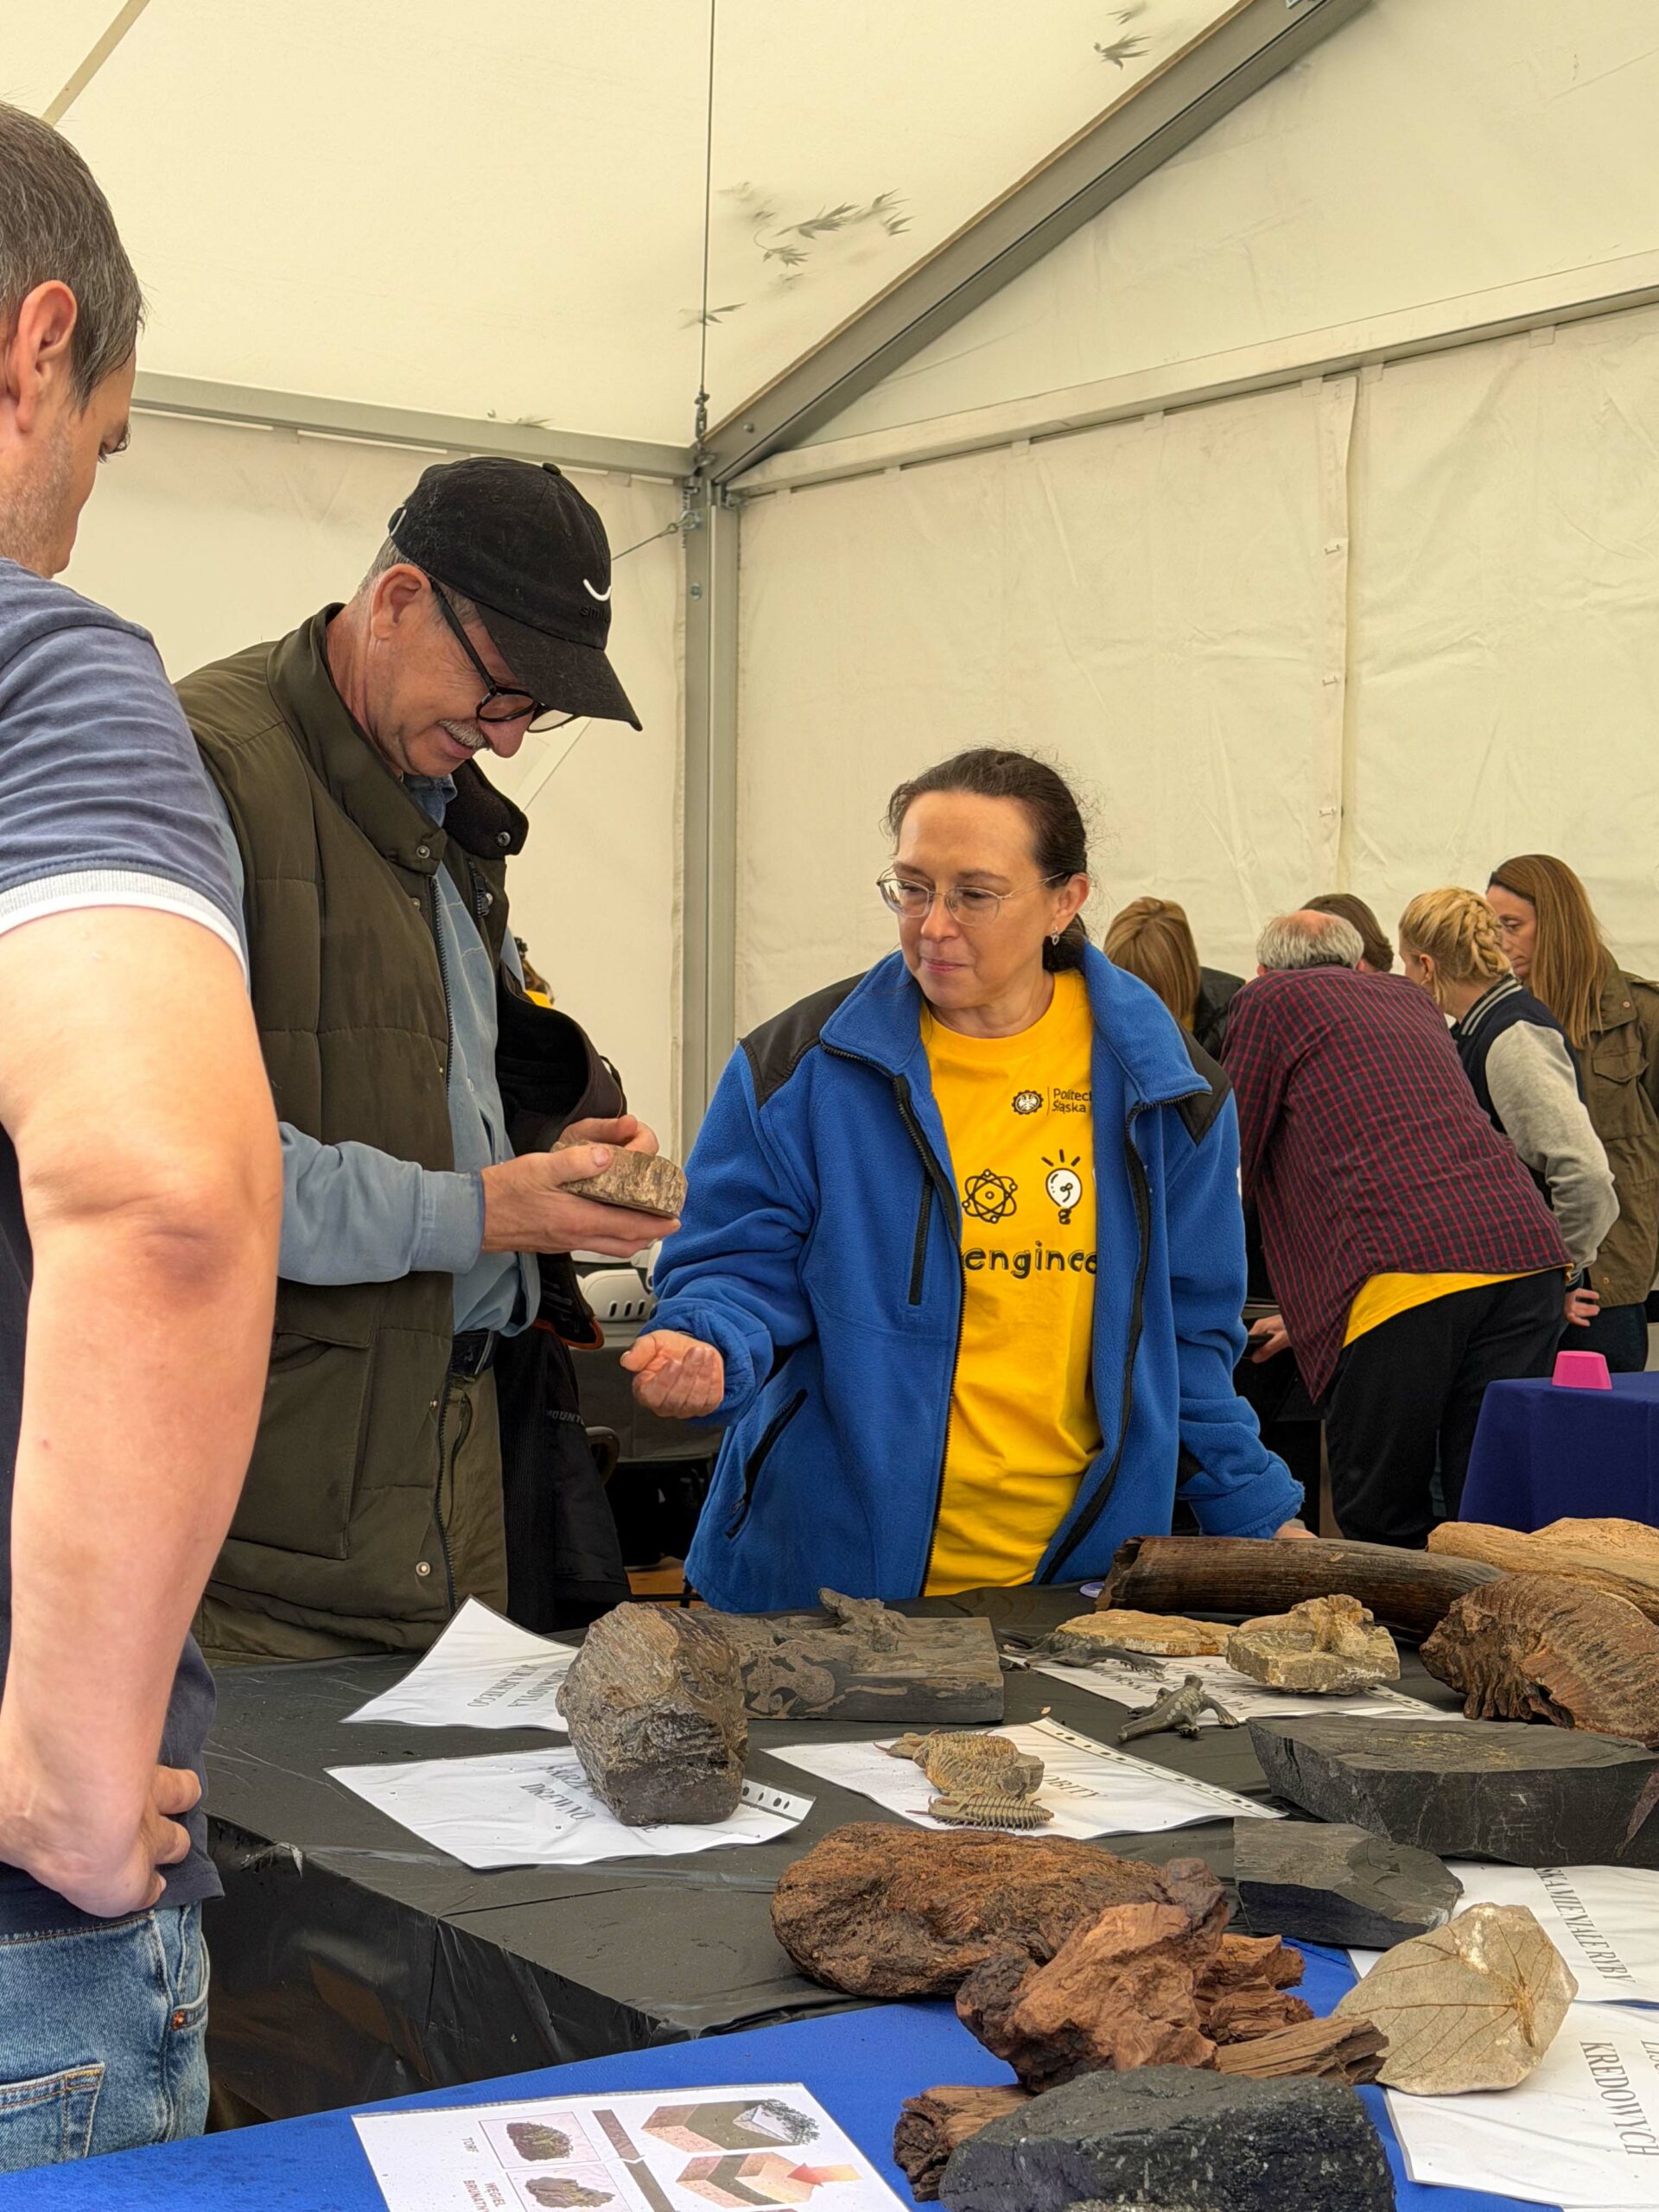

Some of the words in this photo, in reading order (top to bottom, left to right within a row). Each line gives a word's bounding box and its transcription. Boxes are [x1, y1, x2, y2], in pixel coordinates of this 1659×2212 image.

[518, 1783, 596, 1821] DREWNO
[1585, 1950, 1637, 1984] RYBY
[1580, 2040, 1659, 2156] KREDOWYCH
[461, 2136, 480, 2153] TORF
[463, 2179, 490, 2212] BRUNATN
